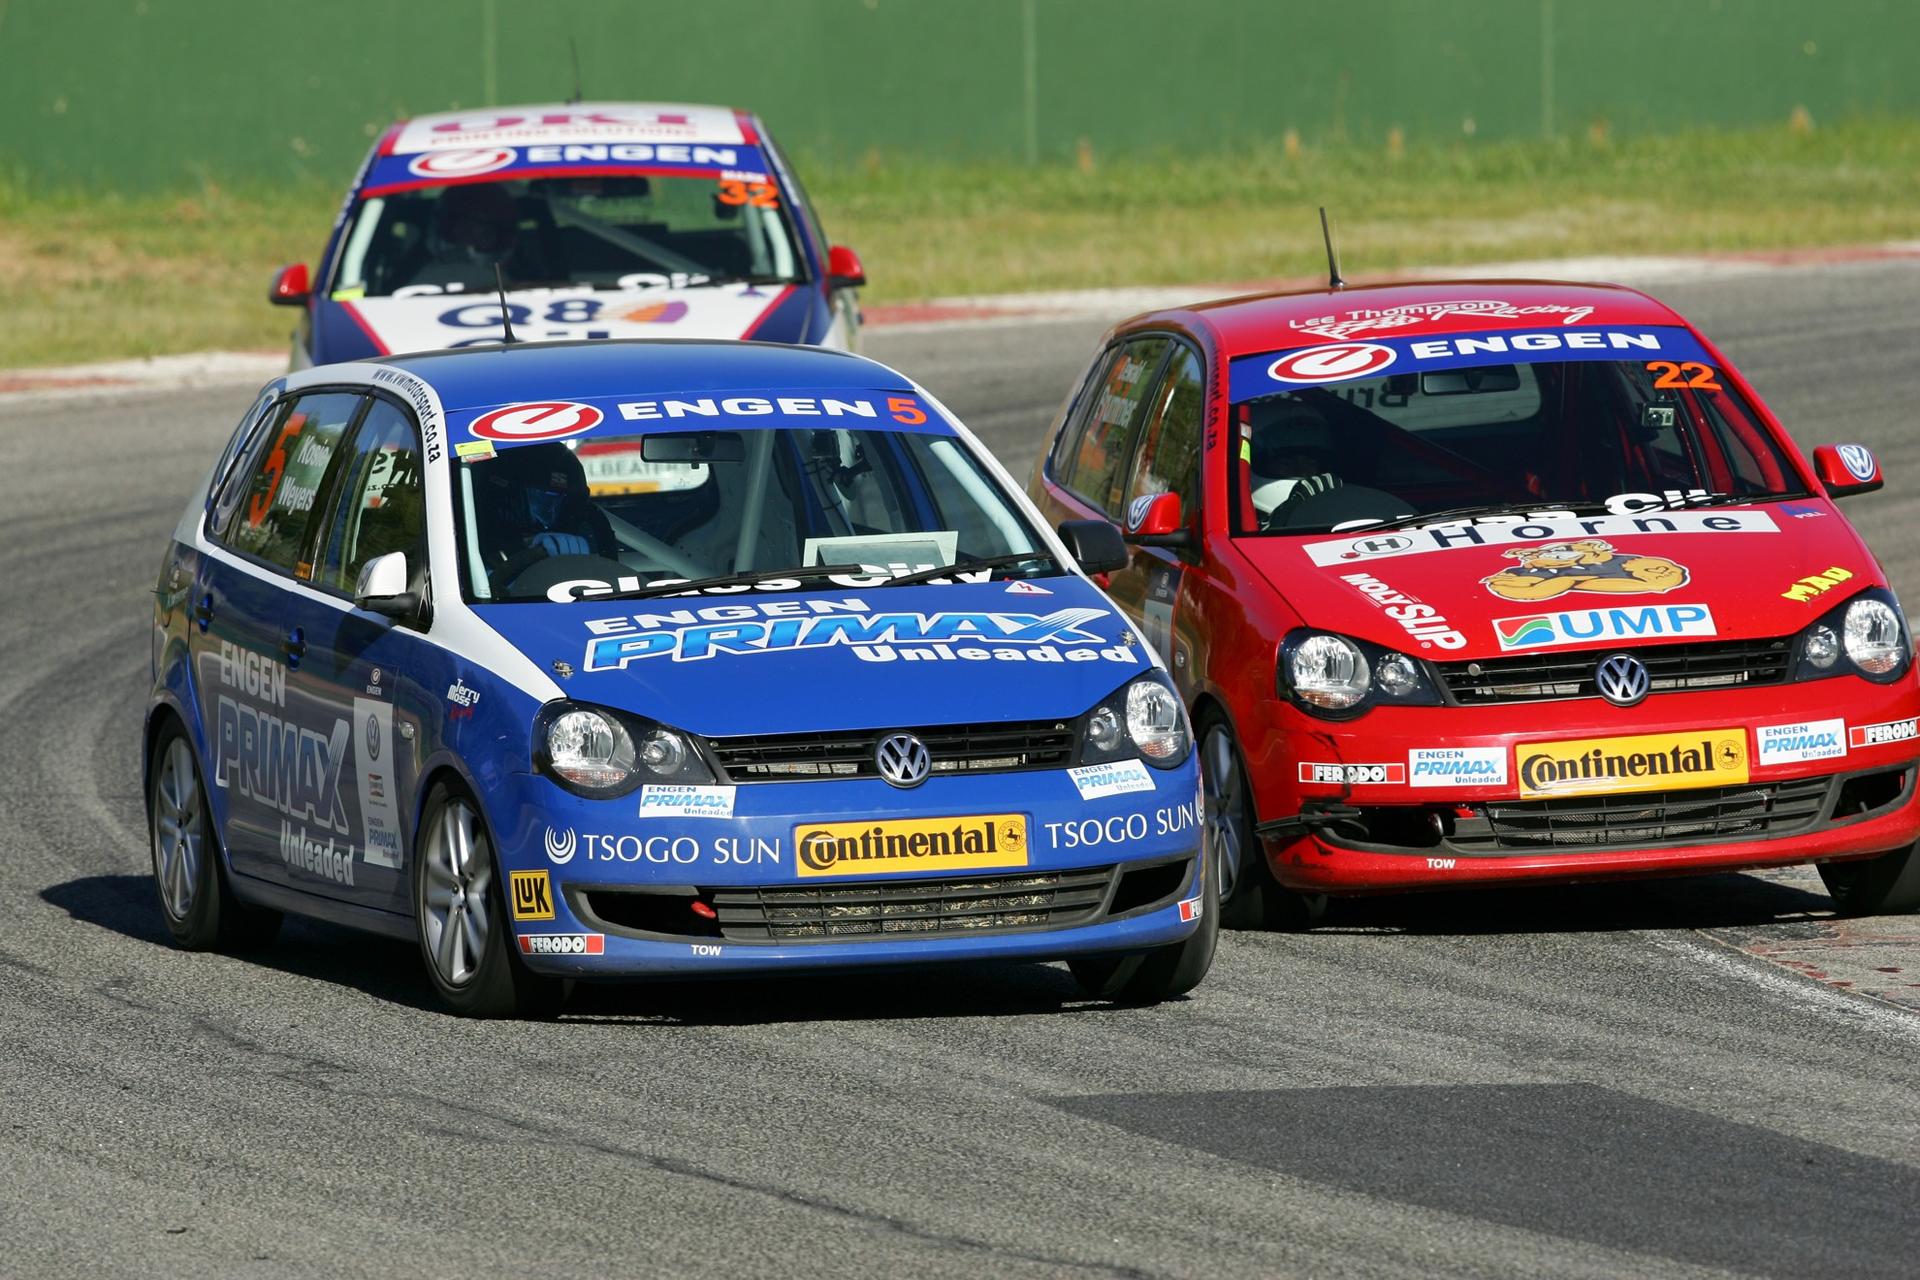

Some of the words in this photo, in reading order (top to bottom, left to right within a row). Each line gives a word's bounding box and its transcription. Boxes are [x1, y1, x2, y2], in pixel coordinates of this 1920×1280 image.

[528, 145, 737, 166] ENGEN
[718, 180, 779, 209] 32
[438, 300, 603, 328] Q8
[1345, 301, 1502, 321] Thompson
[1410, 333, 1661, 359] ENGEN
[1646, 361, 1722, 391] 22
[617, 398, 877, 421] ENGEN
[887, 397, 928, 425] 5
[248, 412, 308, 529] 5
[1429, 516, 1743, 549] Horne
[583, 598, 871, 634] ENGEN
[1558, 606, 1706, 639] UMP
[583, 607, 1112, 673] PRIMAX
[852, 644, 1139, 664] Unleaded
[221, 639, 286, 708] ENGEN
[457, 678, 480, 703] Terry
[1763, 731, 1838, 754] PRIMAX
[1765, 725, 1808, 737] ENGEN
[1867, 720, 1917, 744] FERODO
[1418, 750, 1464, 760] ENGEN
[1801, 747, 1842, 759] Unleaded
[216, 695, 350, 836] PRIMAX
[1073, 764, 1113, 776] ENGEN
[1414, 759, 1499, 776] PRIMAX
[1521, 741, 1715, 791] Continental
[1077, 769, 1147, 790] PRIMAX
[1455, 776, 1502, 784] Unleaded
[641, 794, 729, 808] PRIMAX
[683, 808, 733, 816] Unleaded
[1044, 814, 1147, 849] TSOGO
[1156, 802, 1194, 835] SUN
[280, 819, 354, 886] Unleaded
[583, 835, 700, 863] TSOGO
[713, 838, 780, 864] SUN
[800, 821, 998, 871] Continental
[1426, 858, 1456, 869] TOW
[529, 936, 585, 953] FERODO
[691, 945, 722, 956] TOW
